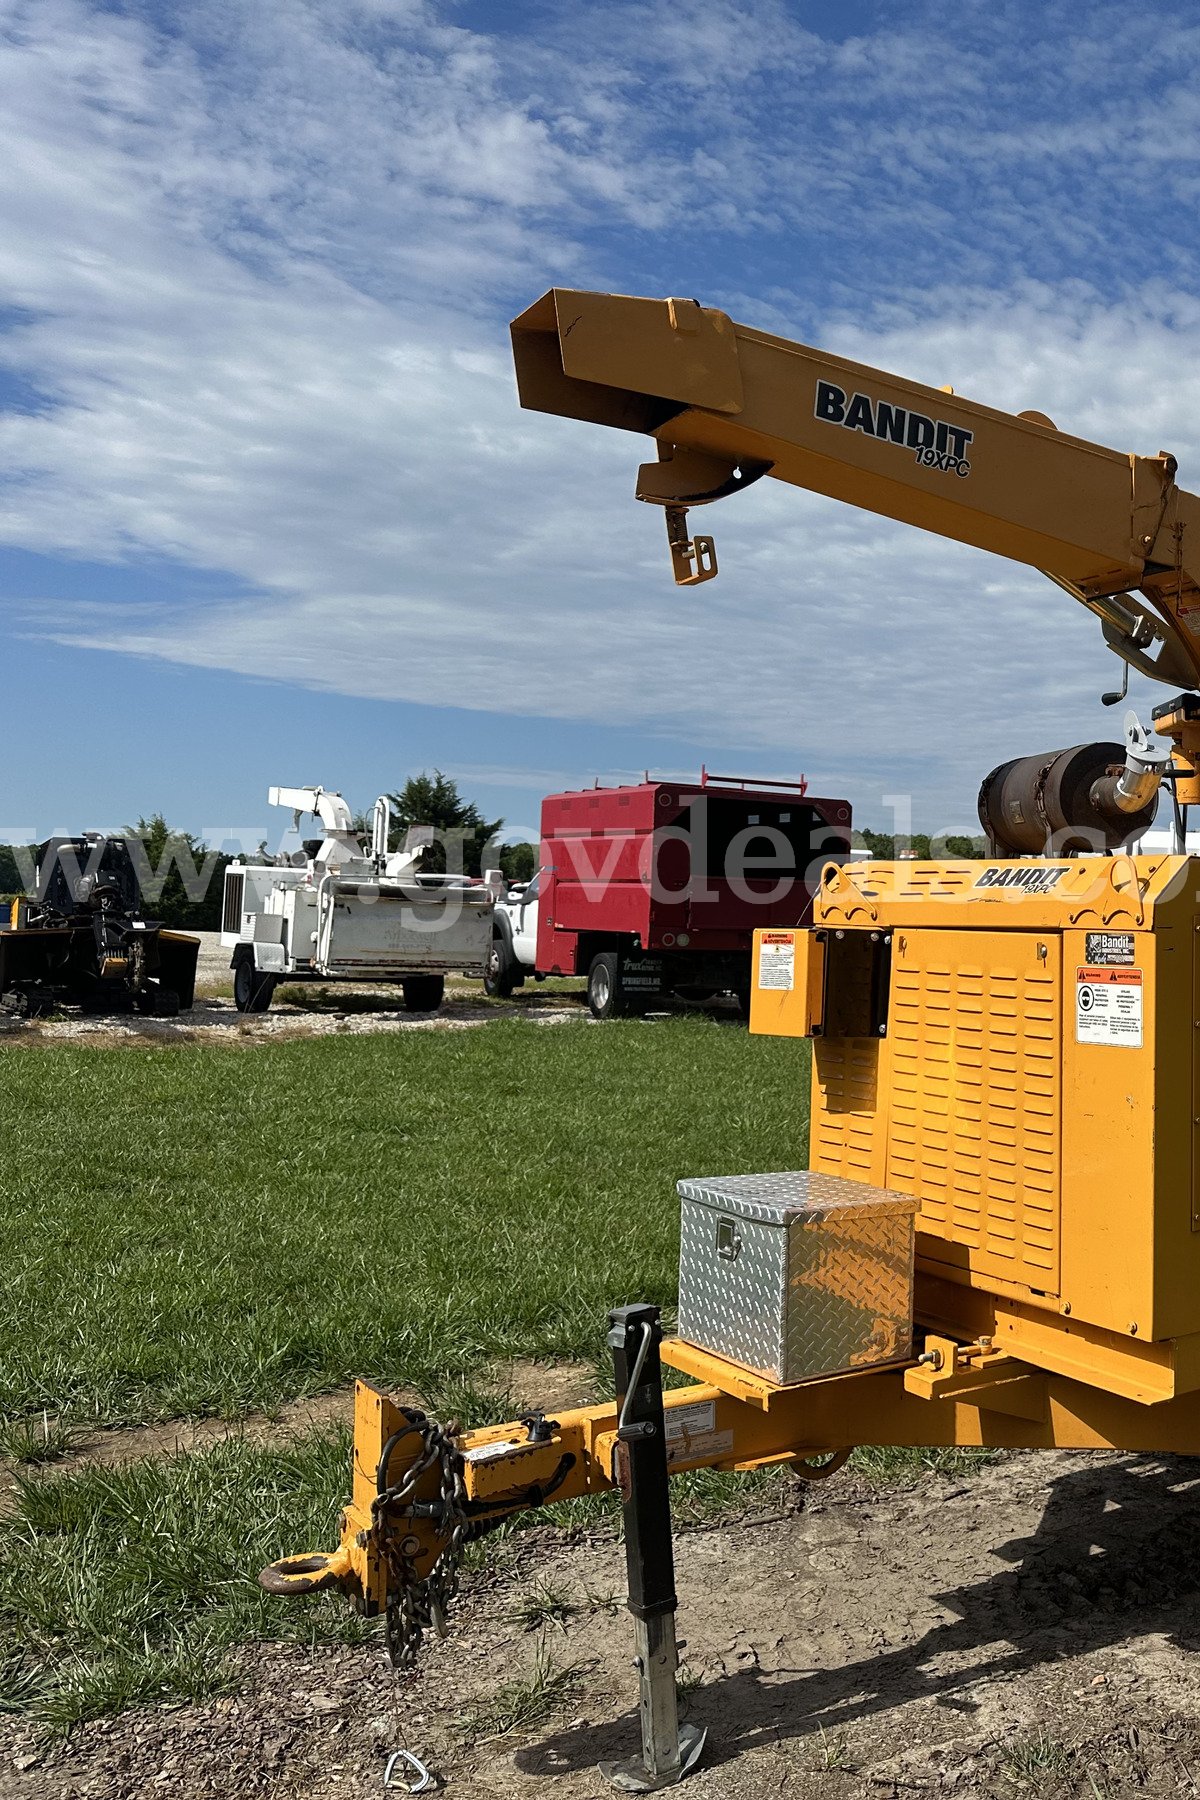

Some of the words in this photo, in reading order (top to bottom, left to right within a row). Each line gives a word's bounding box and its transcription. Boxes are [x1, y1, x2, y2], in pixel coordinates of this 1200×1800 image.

[814, 379, 973, 459] BANDIT
[914, 445, 971, 478] 19XPC
[974, 867, 1071, 887] BANDIT
[1102, 935, 1130, 948] Bandit
